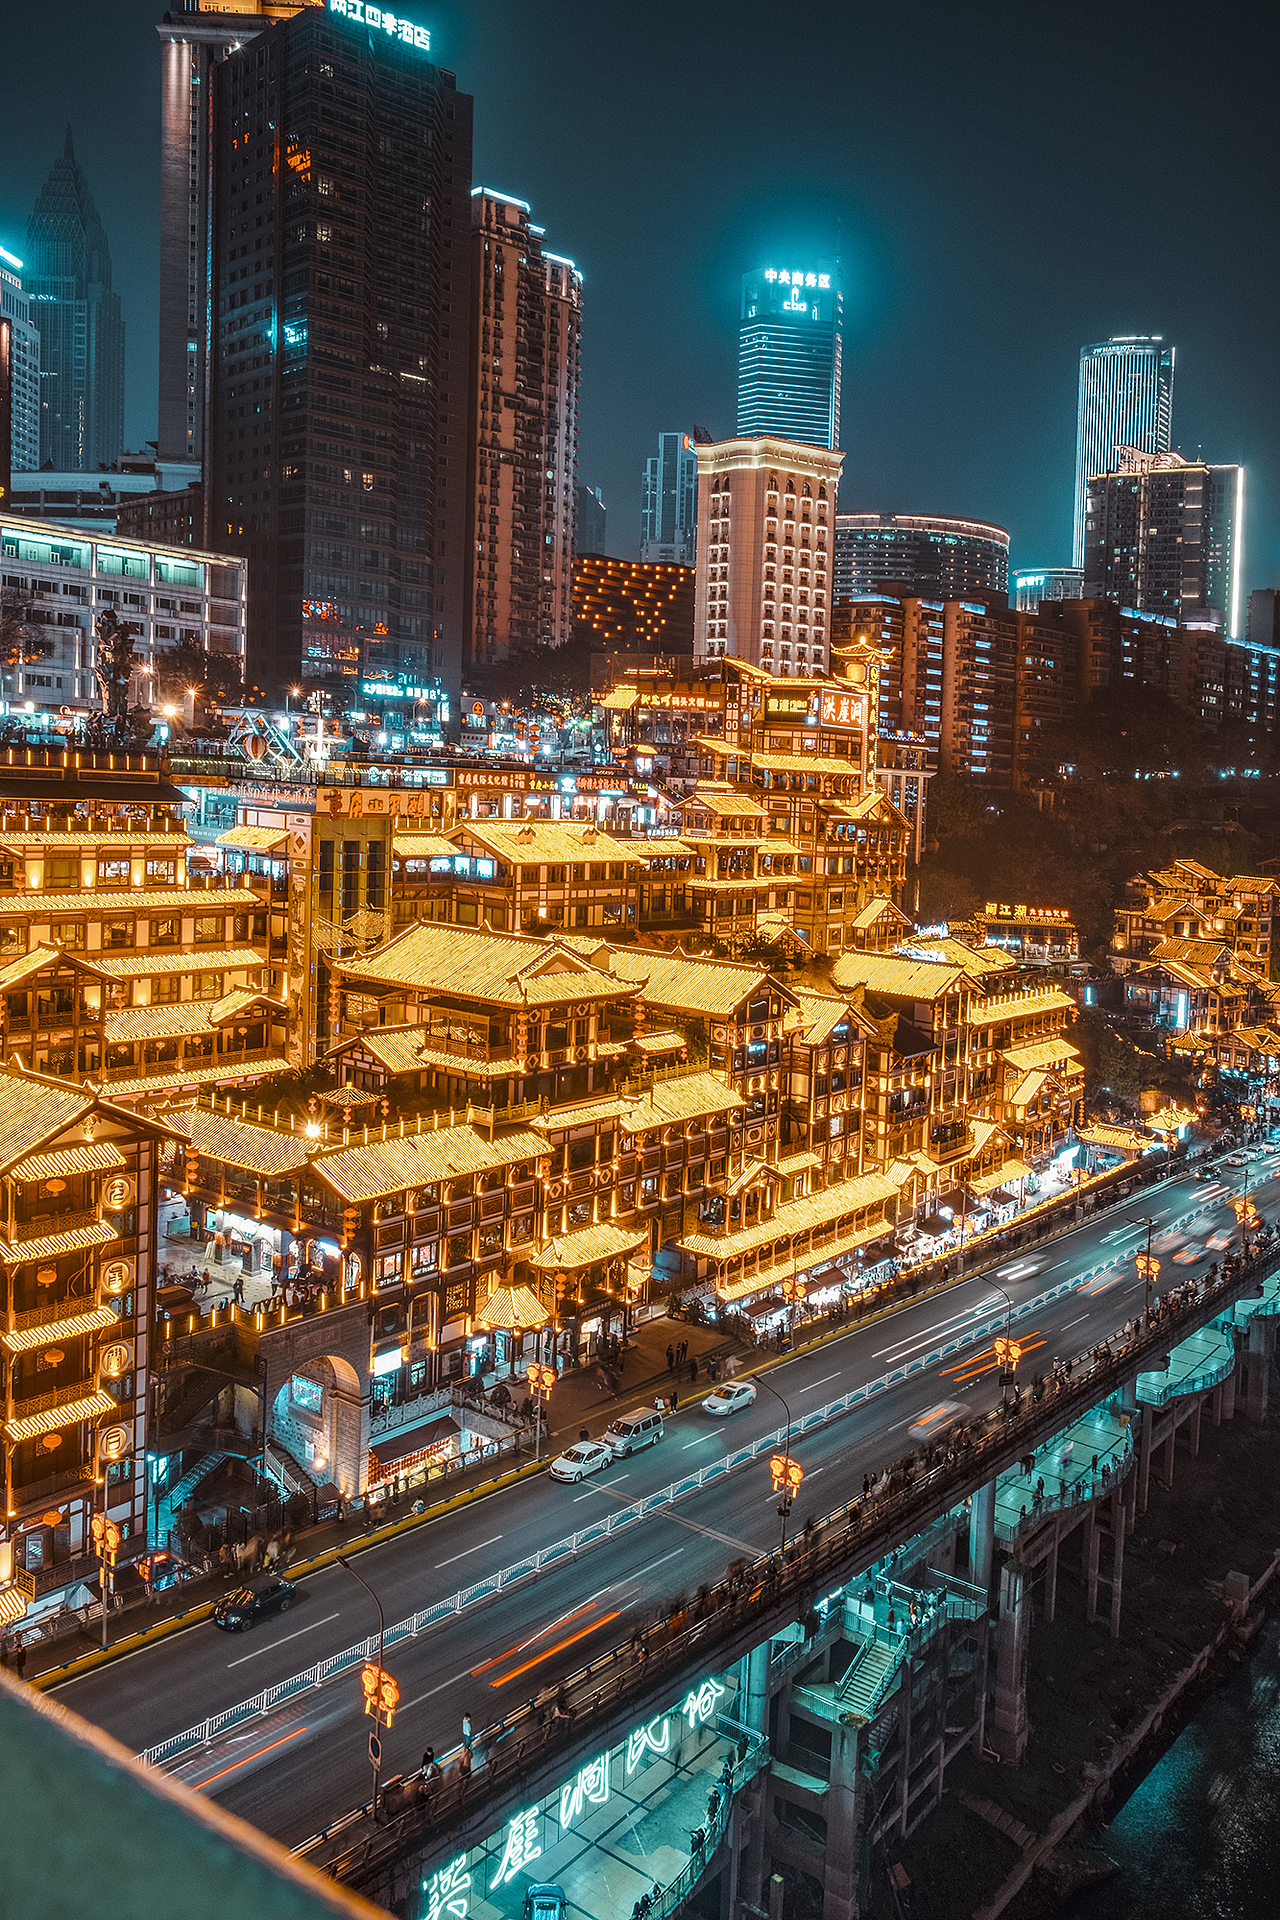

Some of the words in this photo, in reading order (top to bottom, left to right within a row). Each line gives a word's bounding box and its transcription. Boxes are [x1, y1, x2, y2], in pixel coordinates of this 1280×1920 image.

[330, 0, 430, 51] 两江四季酒店
[765, 268, 830, 288] 中央商务区
[823, 695, 862, 725] 洪崖洞
